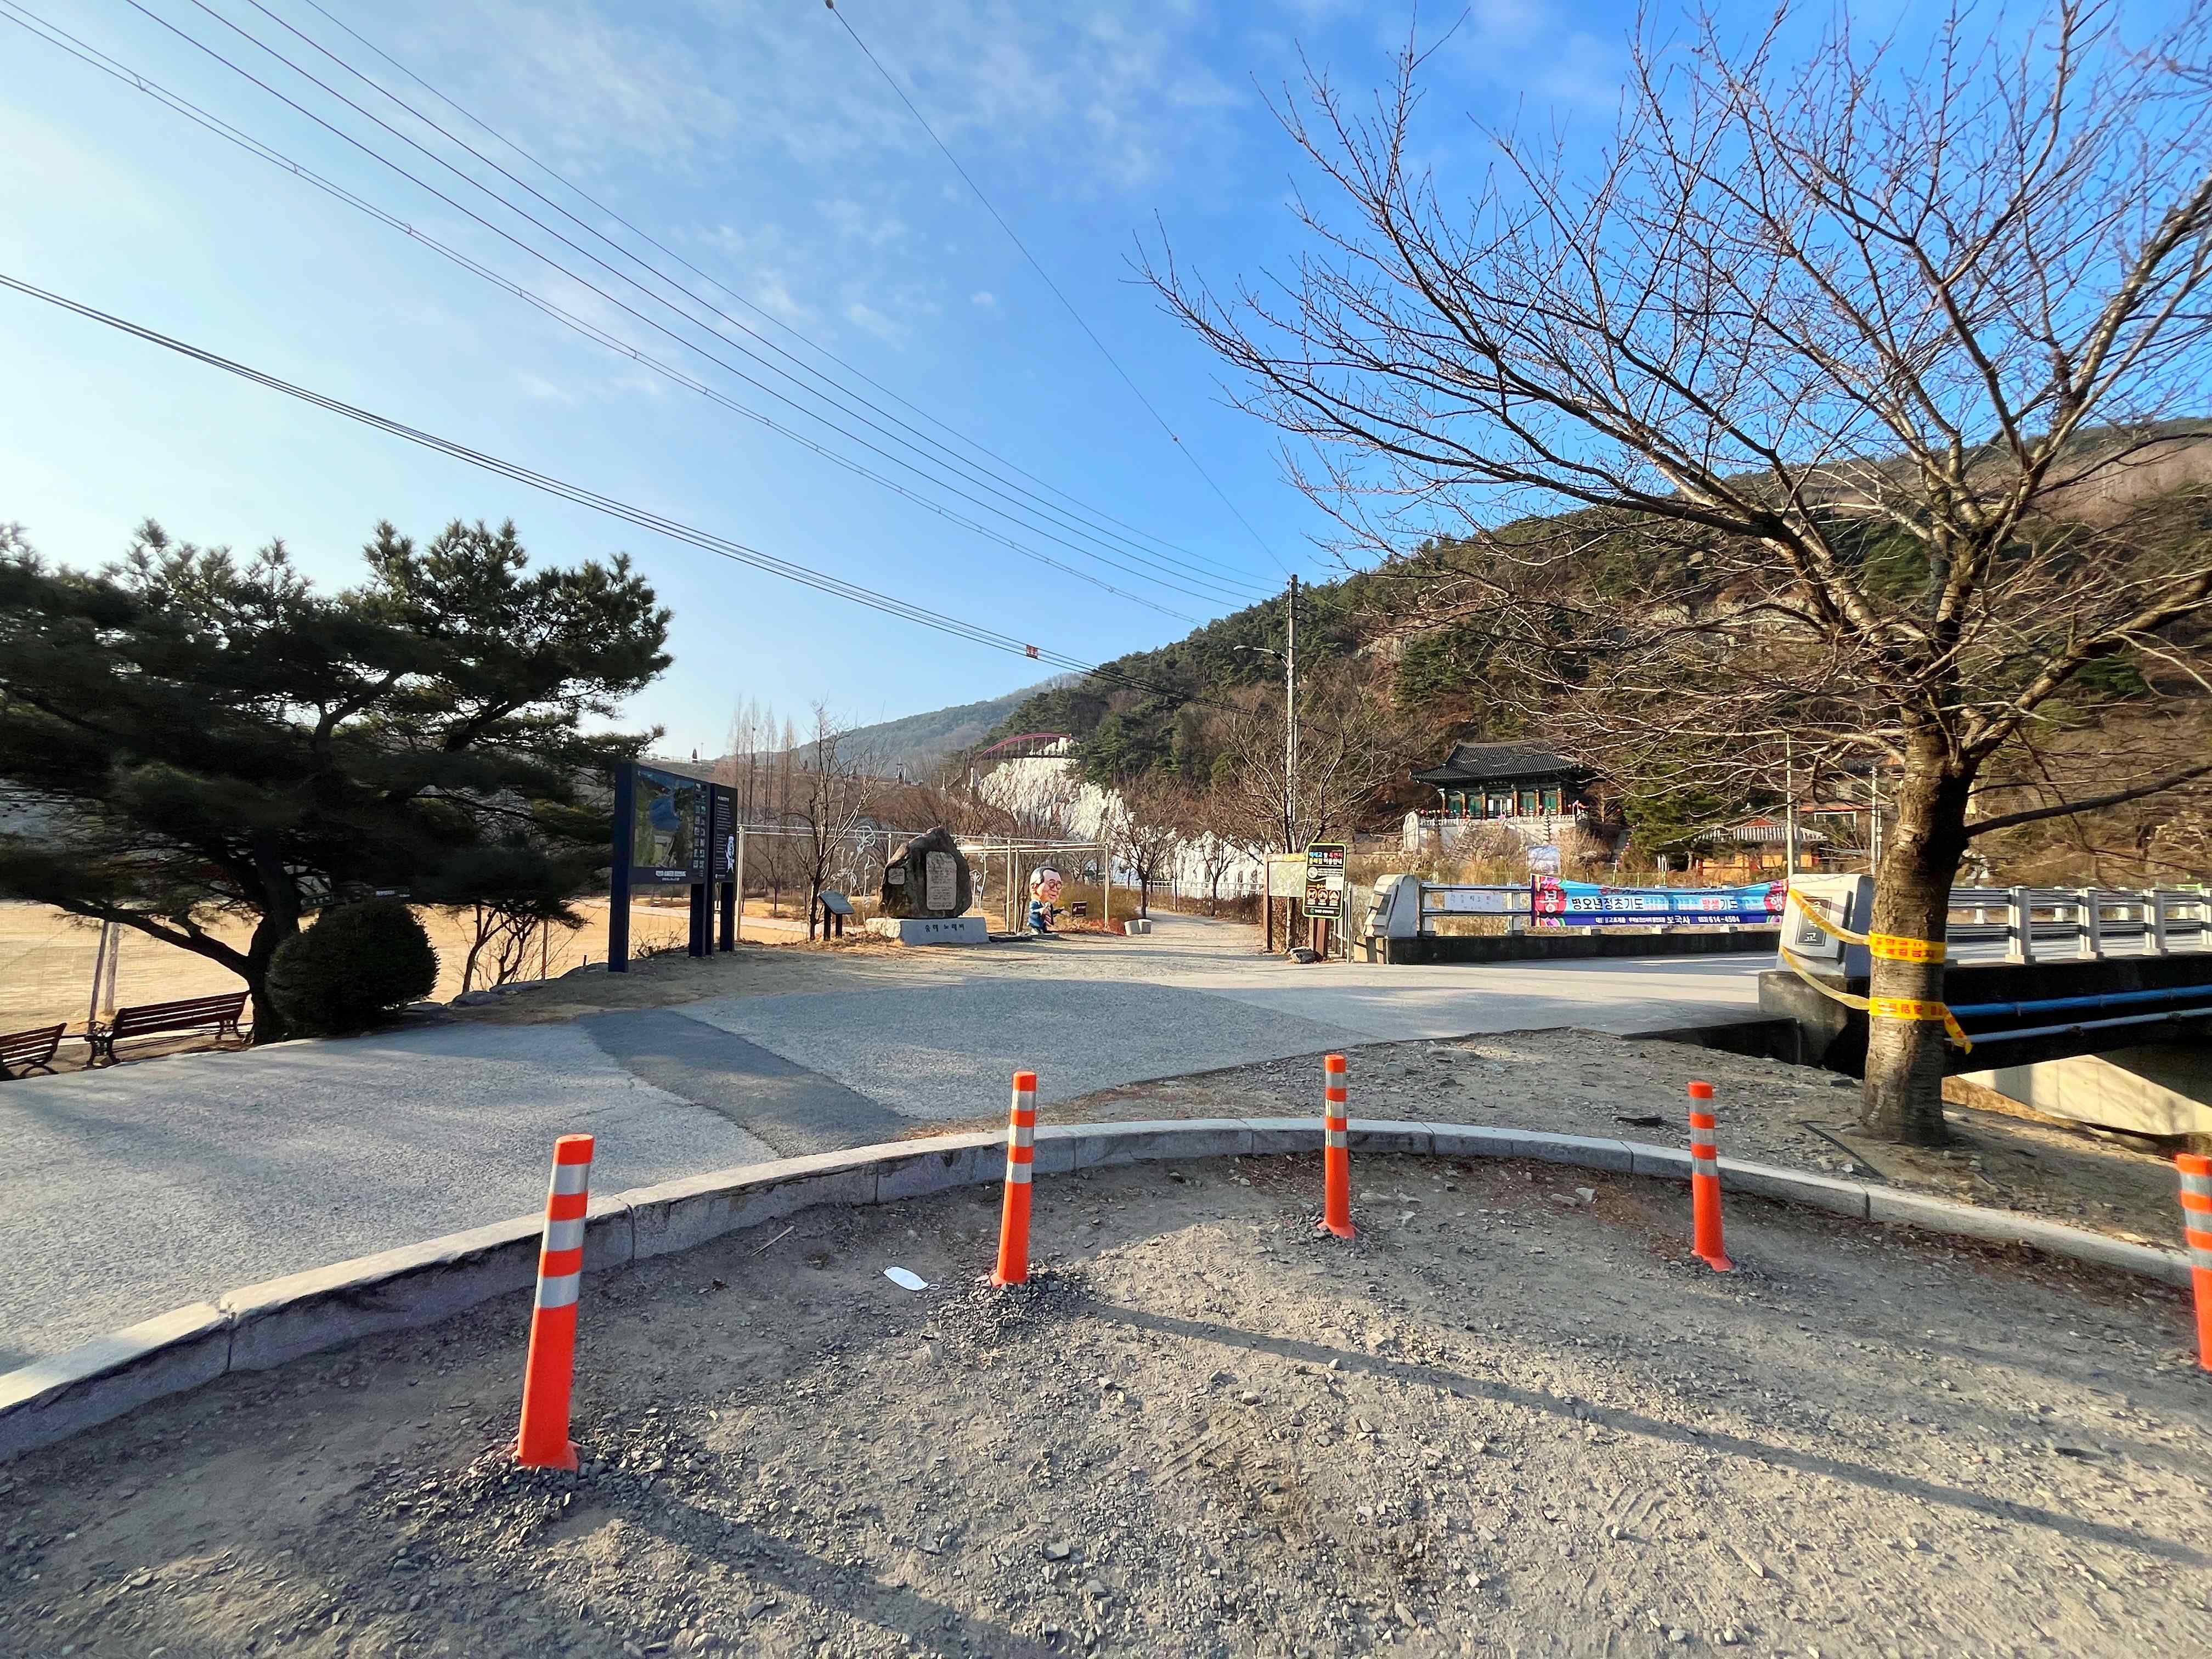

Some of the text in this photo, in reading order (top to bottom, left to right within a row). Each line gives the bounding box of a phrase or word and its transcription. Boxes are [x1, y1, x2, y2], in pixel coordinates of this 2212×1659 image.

[1539, 890, 1559, 913] 봉
[1770, 891, 1783, 912] 행
[1667, 915, 1690, 924] 보국사
